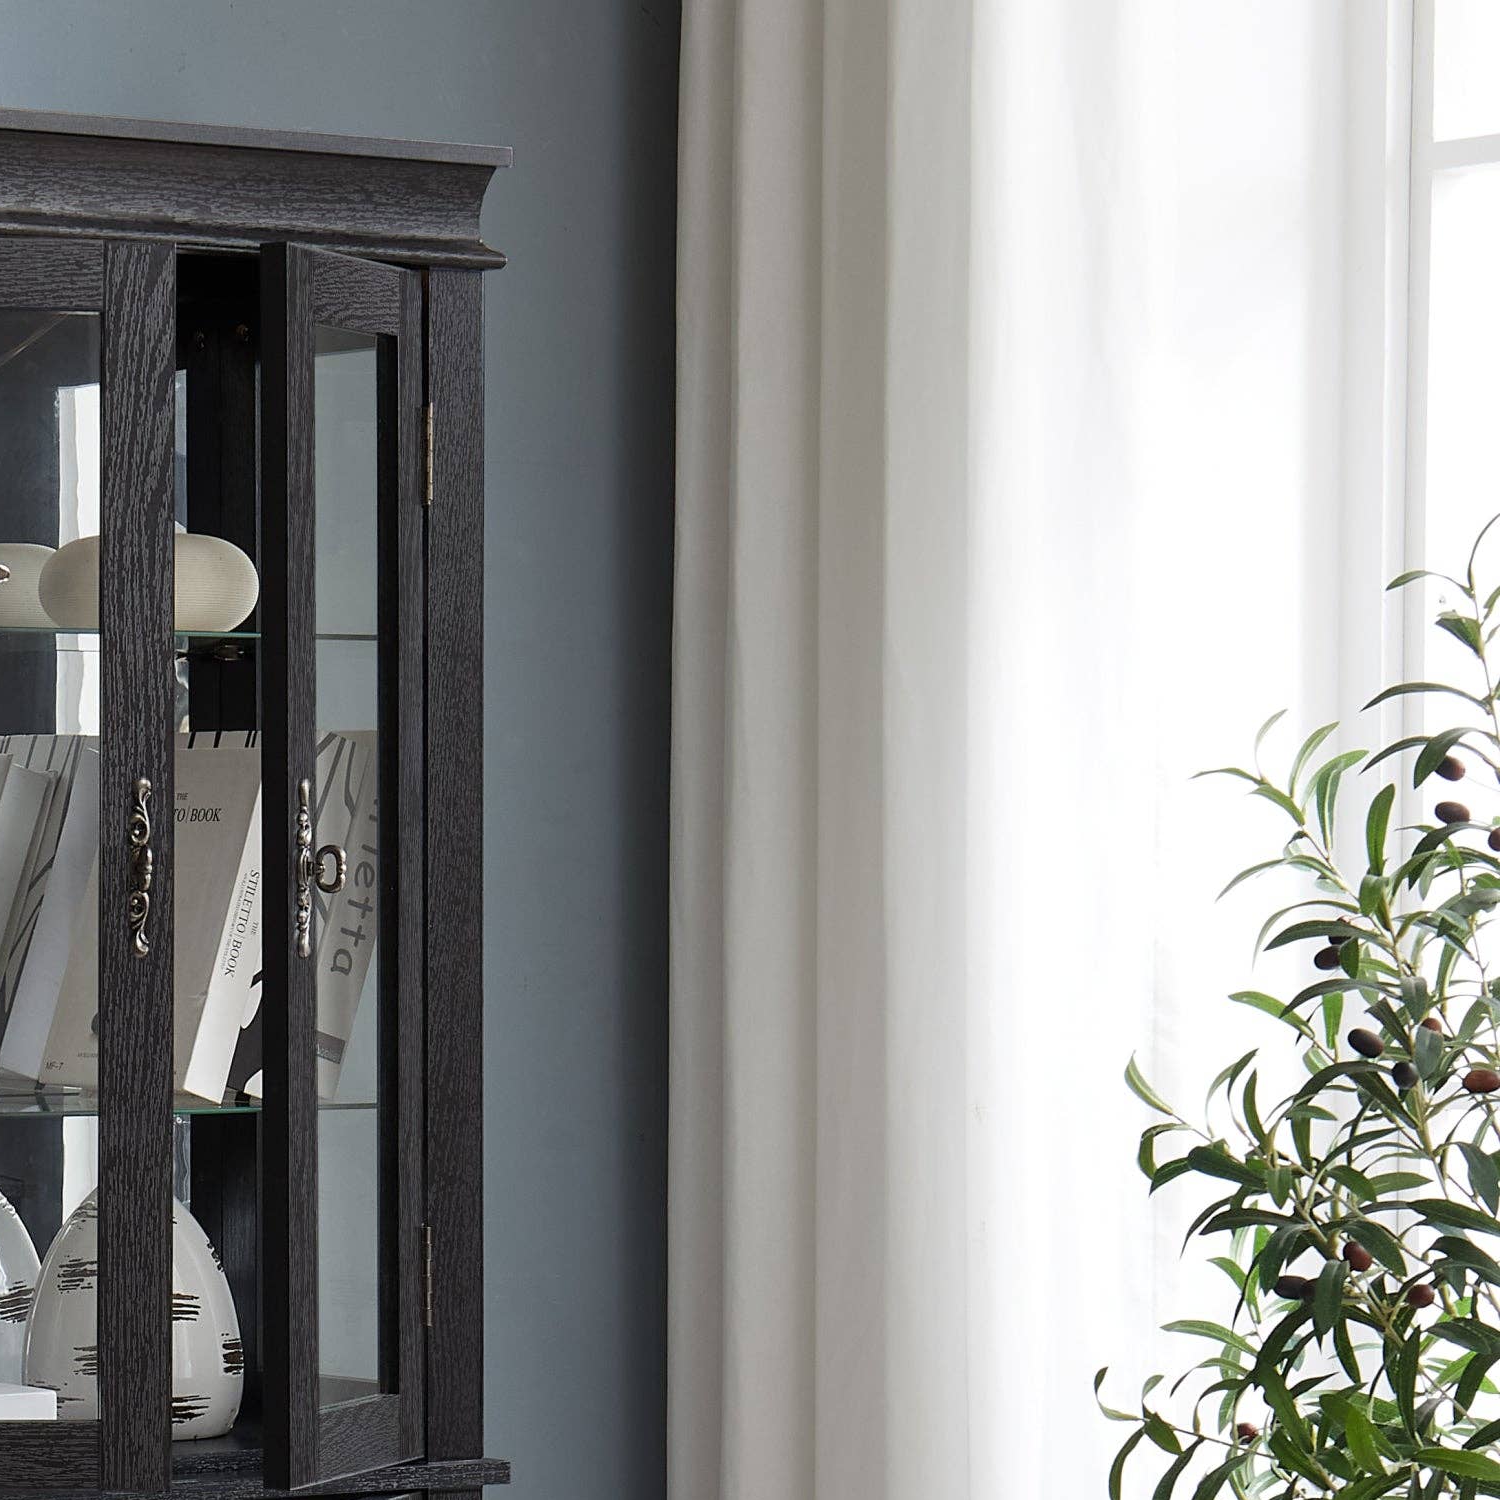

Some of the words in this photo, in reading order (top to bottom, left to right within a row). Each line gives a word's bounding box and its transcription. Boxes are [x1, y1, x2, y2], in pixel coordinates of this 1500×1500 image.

[190, 808, 222, 822] BOOK
[236, 869, 261, 934] STILETTO
[330, 812, 378, 976] letta
[224, 939, 243, 978] BOOK
